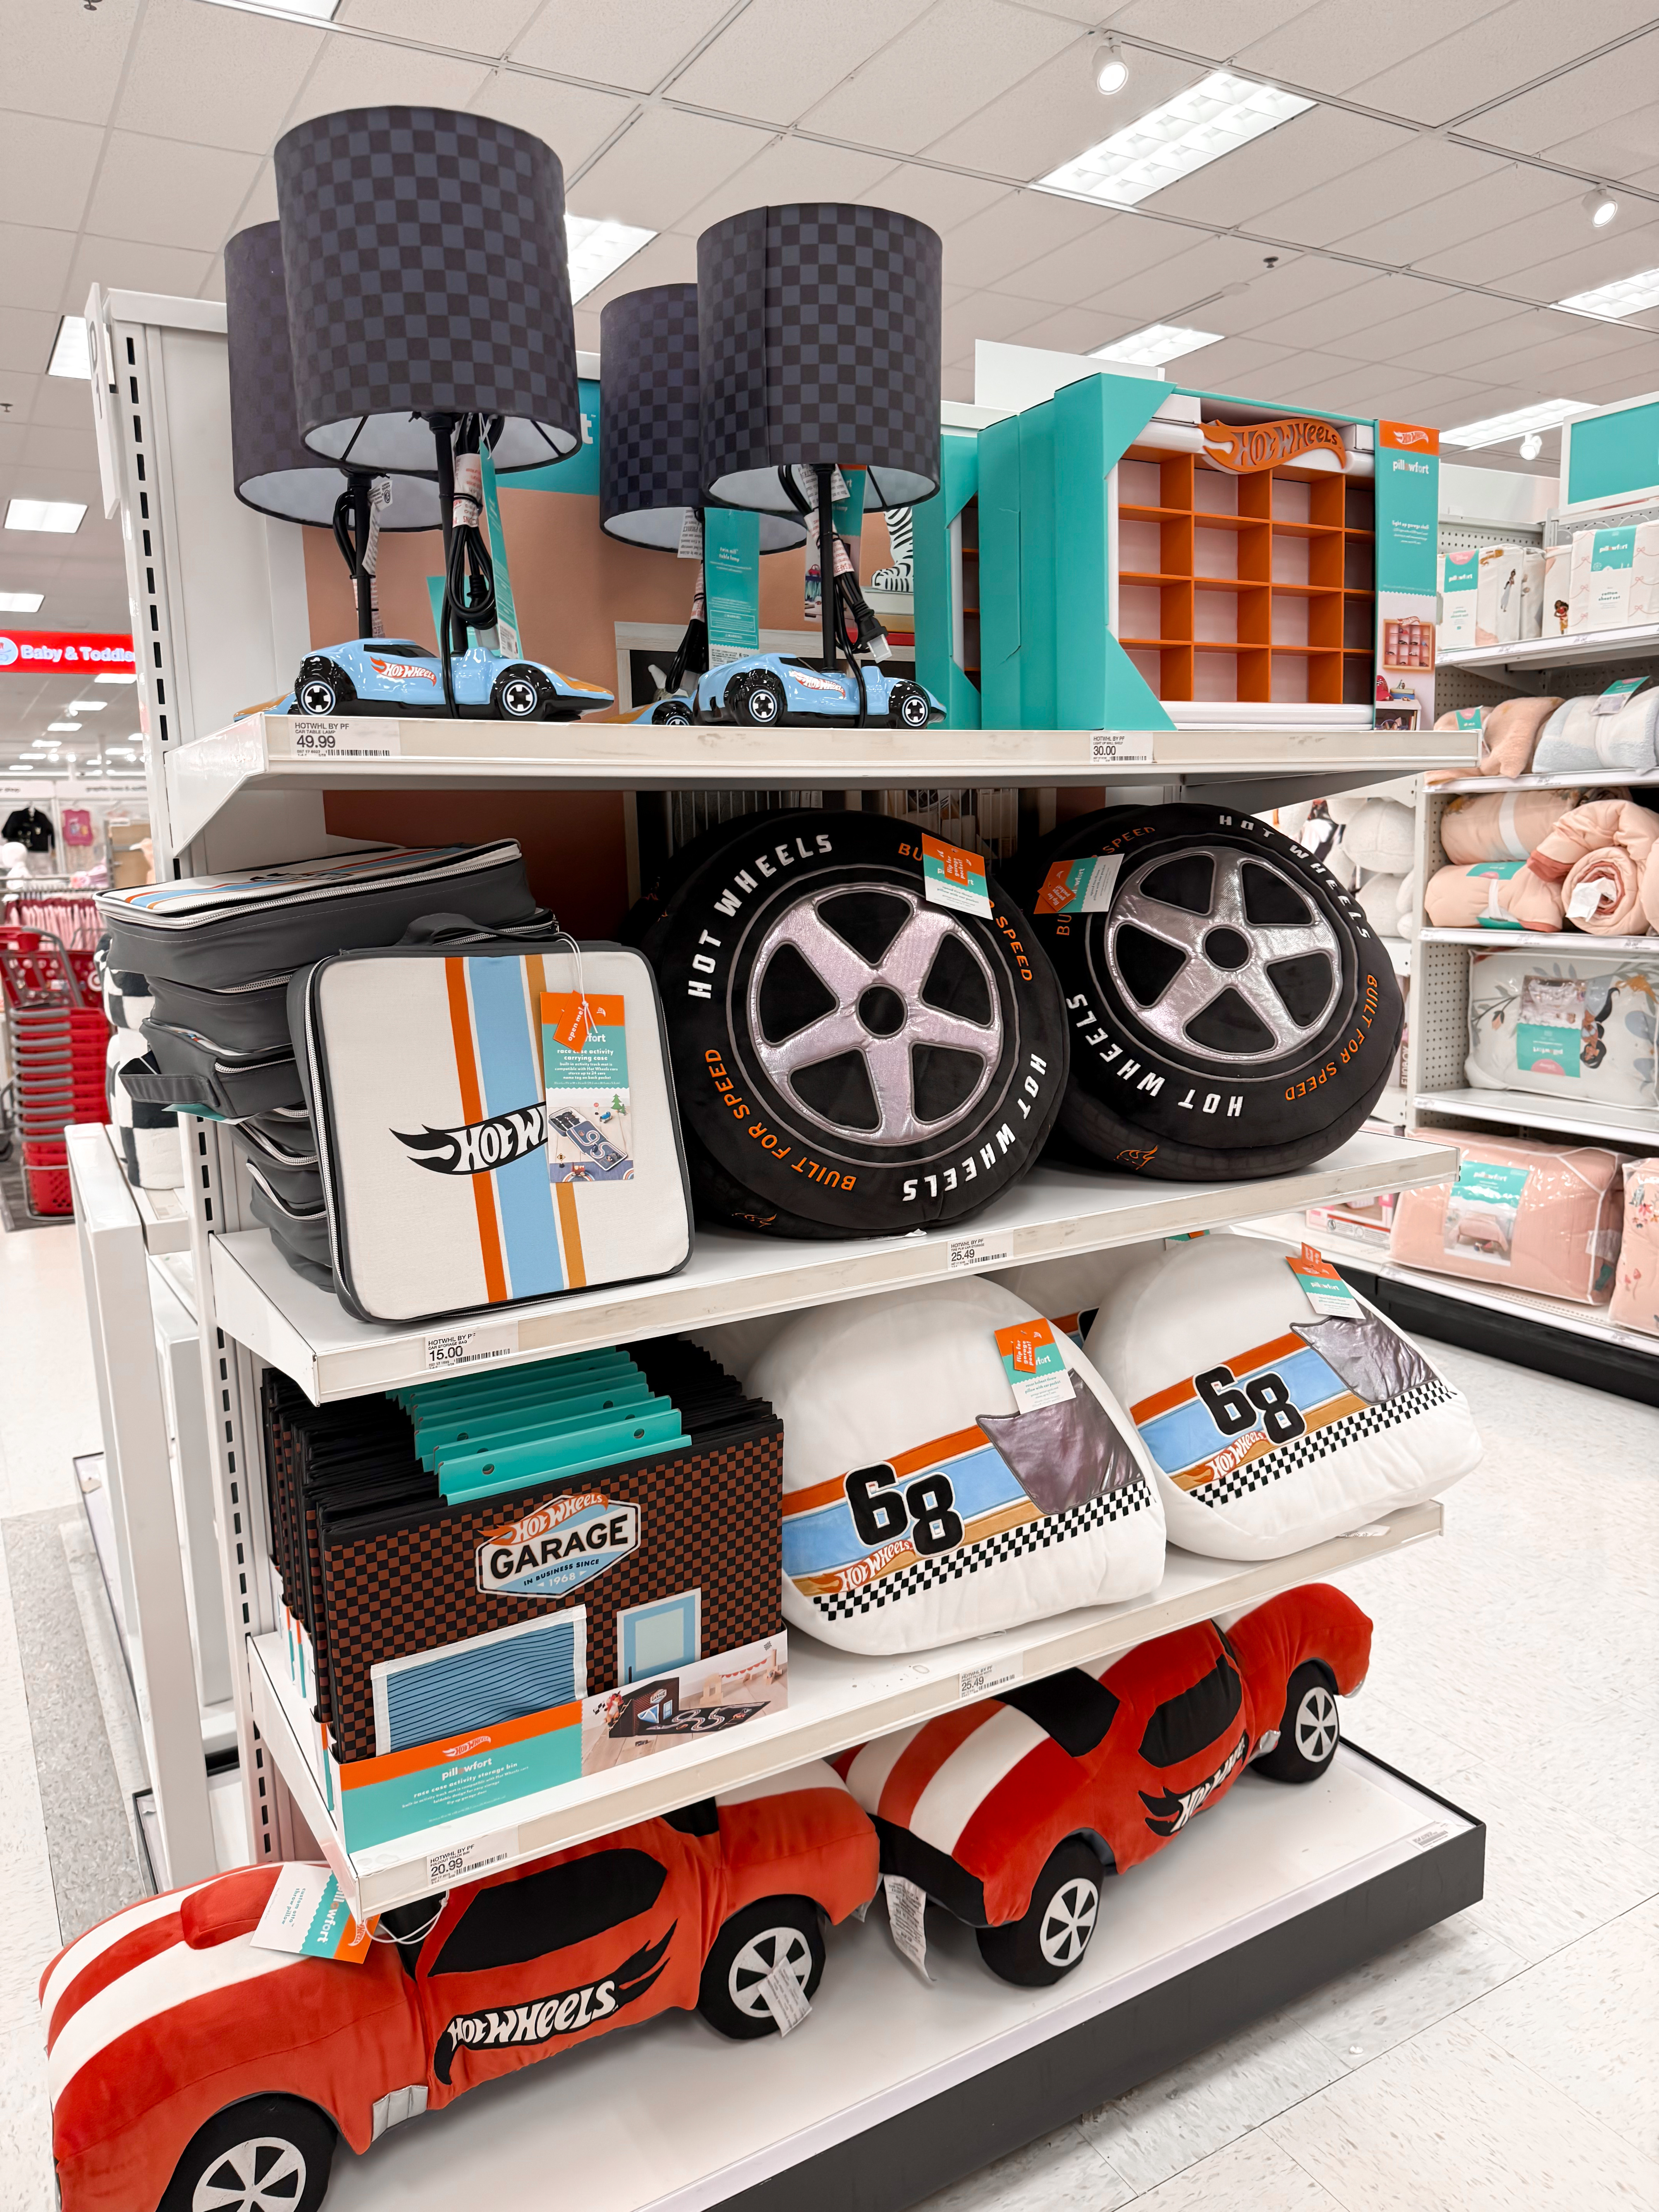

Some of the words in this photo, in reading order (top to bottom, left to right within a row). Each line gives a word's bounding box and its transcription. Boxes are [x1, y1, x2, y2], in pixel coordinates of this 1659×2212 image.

[1393, 459, 1429, 474] pillowfort
[21, 645, 62, 662] Baby
[65, 646, 78, 660] &
[79, 647, 135, 662] Toddle
[297, 735, 336, 748] 49.99
[1093, 746, 1116, 755] 30.00
[1102, 826, 1156, 854] SPEED
[714, 834, 833, 917] WHEELS
[1219, 814, 1275, 838] HOT
[1289, 844, 1370, 939] WHEELS
[996, 915, 1032, 982] SPEED
[688, 929, 722, 999] HOT
[1362, 974, 1377, 1029] BUILT
[568, 1023, 578, 1042] open
[576, 1006, 585, 1022] me!
[1066, 993, 1166, 1097] WHEELS
[1339, 1029, 1366, 1065] FOR
[705, 1049, 751, 1121] SPEED
[1017, 1053, 1047, 1120] HOT
[1285, 1062, 1338, 1102] SPEED
[1178, 1088, 1244, 1117] HOT
[748, 1121, 792, 1159] FOR
[791, 1156, 857, 1192] BUILT
[902, 1123, 1017, 1202] WHEELS
[951, 1249, 975, 1262] 25.49
[428, 1337, 456, 1346] HOTWHL
[429, 1345, 463, 1361] 15.00
[1194, 1365, 1305, 1445] 68
[844, 1462, 964, 1556] 68
[491, 1513, 628, 1579] GARAGE
[524, 1577, 533, 1586] IN
[536, 1563, 573, 1581] BUSINESS
[576, 1558, 599, 1568] SINCE
[549, 1572, 576, 1587] 1968
[962, 1670, 979, 1680] HOTWHL
[962, 1676, 984, 1692] 25.49
[651, 1691, 666, 1702] GARAGE
[442, 1758, 492, 1781] pillowfort
[449, 1776, 476, 1787] activity
[478, 1767, 504, 1778] storage
[462, 1780, 485, 1790] compatible
[430, 1858, 448, 1867] FOLDOUT
[431, 1851, 456, 1863] HOTWHL
[431, 1858, 463, 1877] 20.99
[290, 1888, 300, 1905] throw
[295, 1888, 305, 1909] custom
[282, 1906, 292, 1925] pillow
